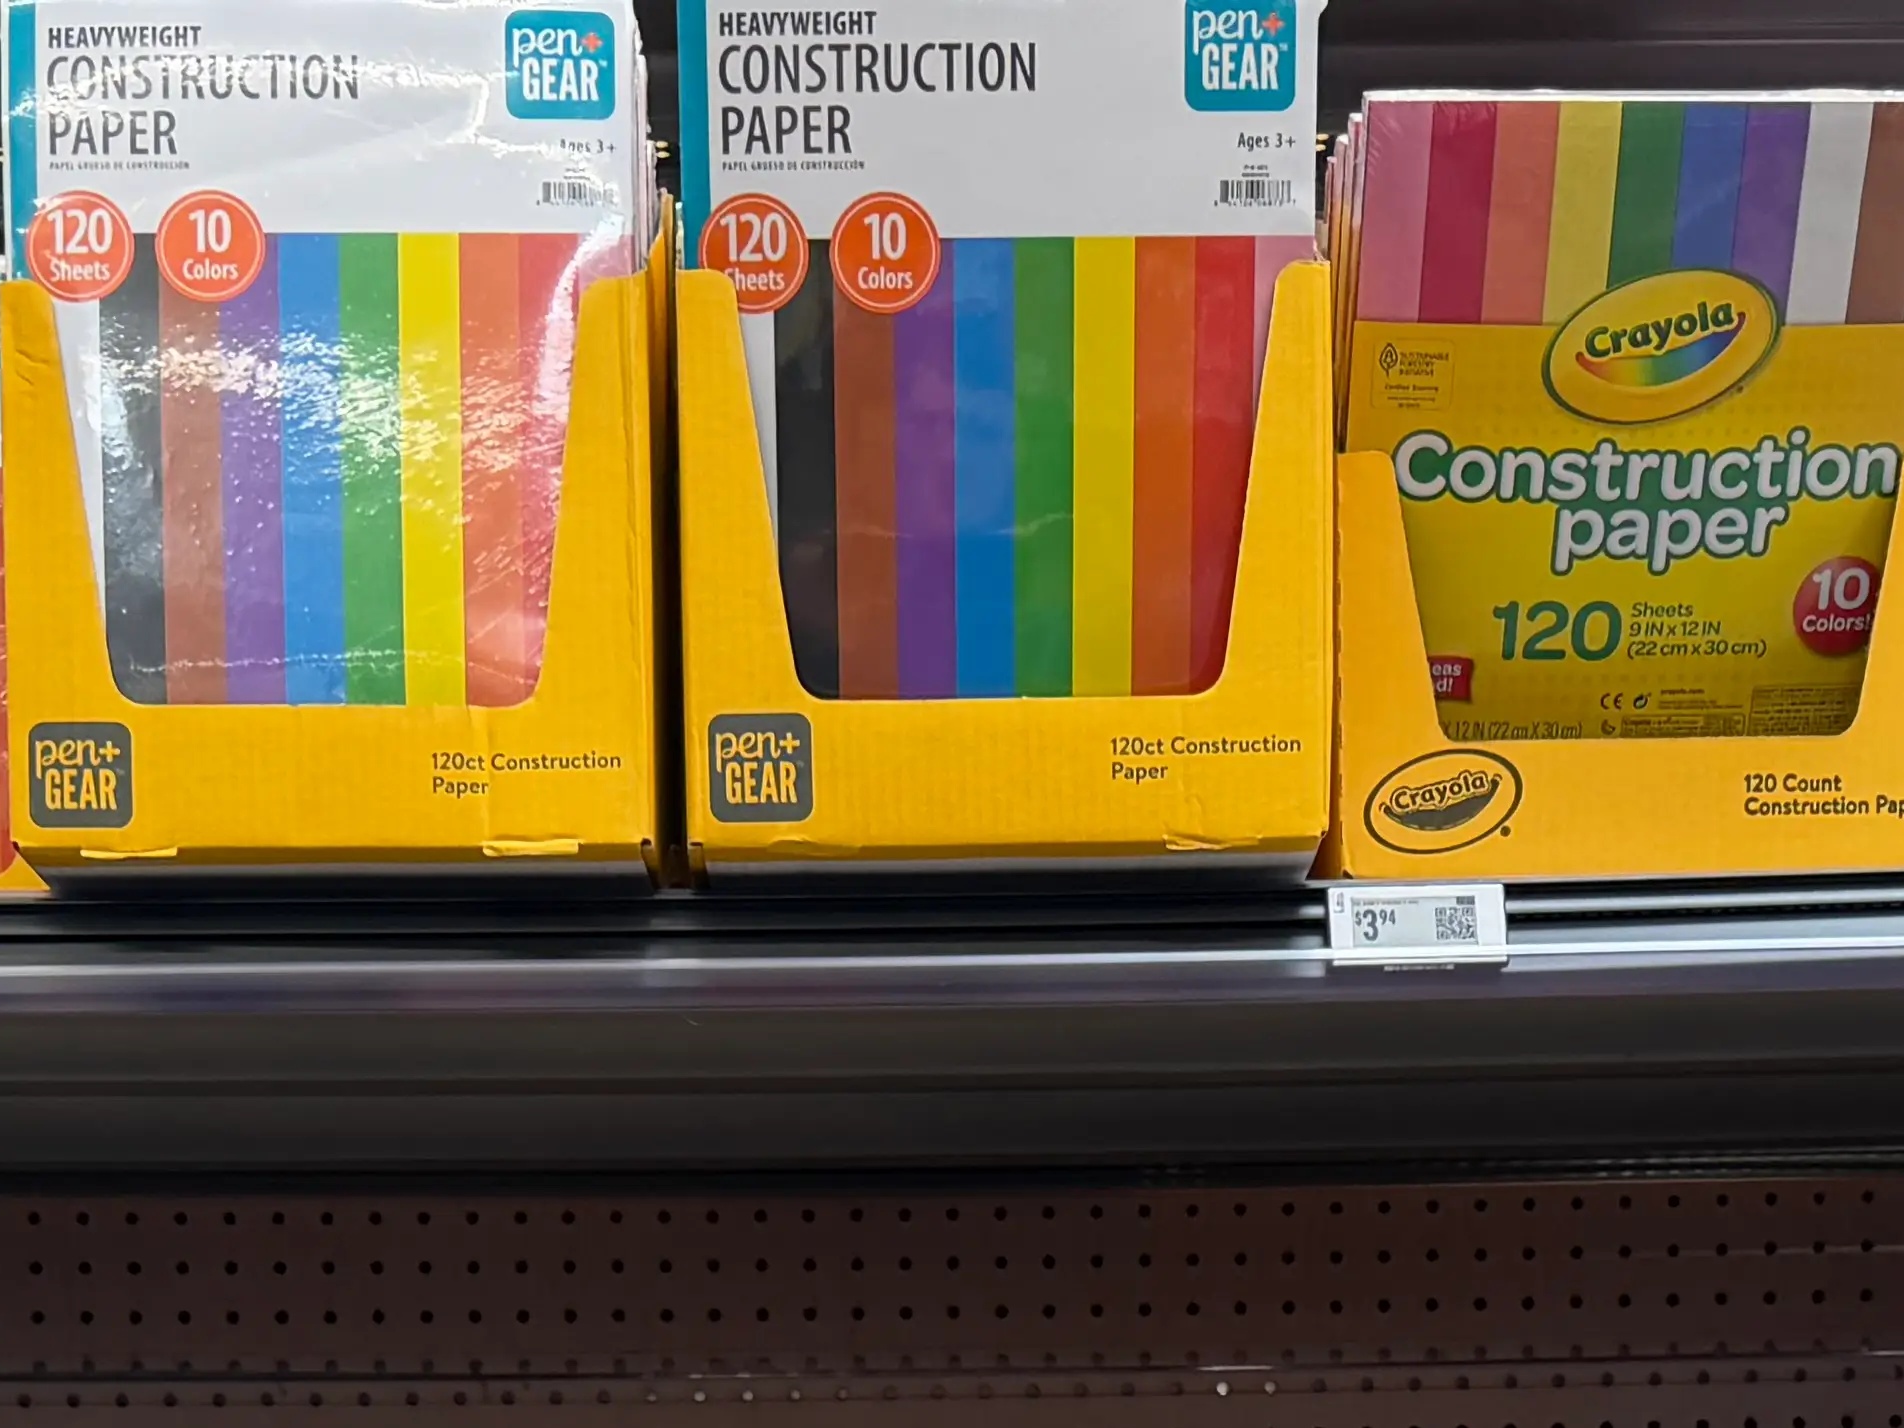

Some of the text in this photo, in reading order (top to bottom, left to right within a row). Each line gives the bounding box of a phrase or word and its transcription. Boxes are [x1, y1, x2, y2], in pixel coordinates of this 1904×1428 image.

[719, 12, 876, 37] HEAVYWEIGHT
[718, 43, 1037, 93] CONSTRUCTION
[722, 106, 852, 155] PAPER
[182, 258, 238, 281] Colors
[1395, 431, 1896, 502] Construction
[1552, 502, 1787, 575] paper
[1632, 601, 1693, 617] Sheets
[1803, 613, 1871, 633] Colors!
[432, 751, 621, 772] 120ct Construction
[1111, 762, 1168, 784] Paper
[45, 770, 117, 811] GEAR
[432, 776, 489, 799] Paper
[1390, 772, 1489, 813] Crayola
[1744, 775, 1842, 793] 120 Count
[1744, 796, 1869, 817] Construction
